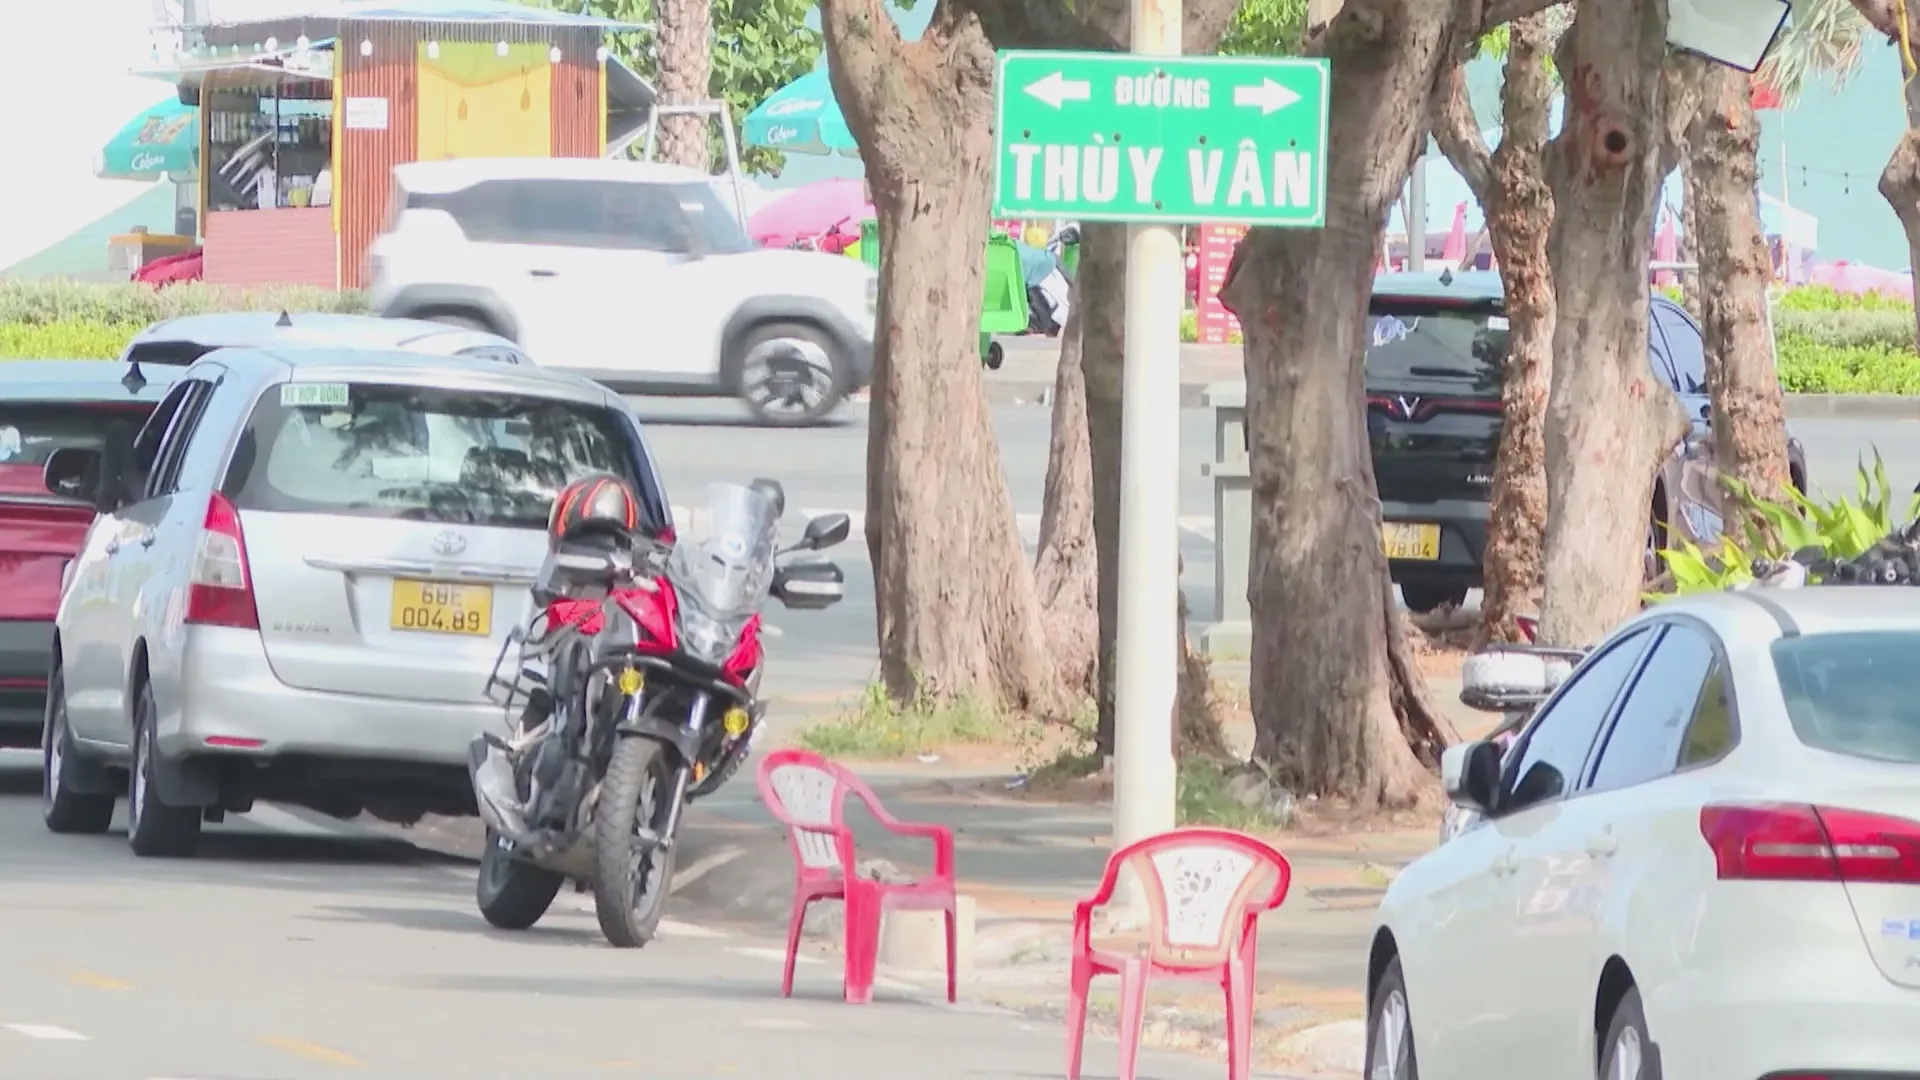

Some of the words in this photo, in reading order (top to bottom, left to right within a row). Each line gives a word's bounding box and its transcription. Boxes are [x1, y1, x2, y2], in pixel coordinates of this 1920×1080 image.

[1114, 68, 1211, 109] ĐƯỜNG
[1009, 133, 1164, 205] THÙY
[1188, 138, 1312, 208] VÂN
[1385, 541, 1430, 557] 78.04
[402, 607, 480, 632] 004.89
